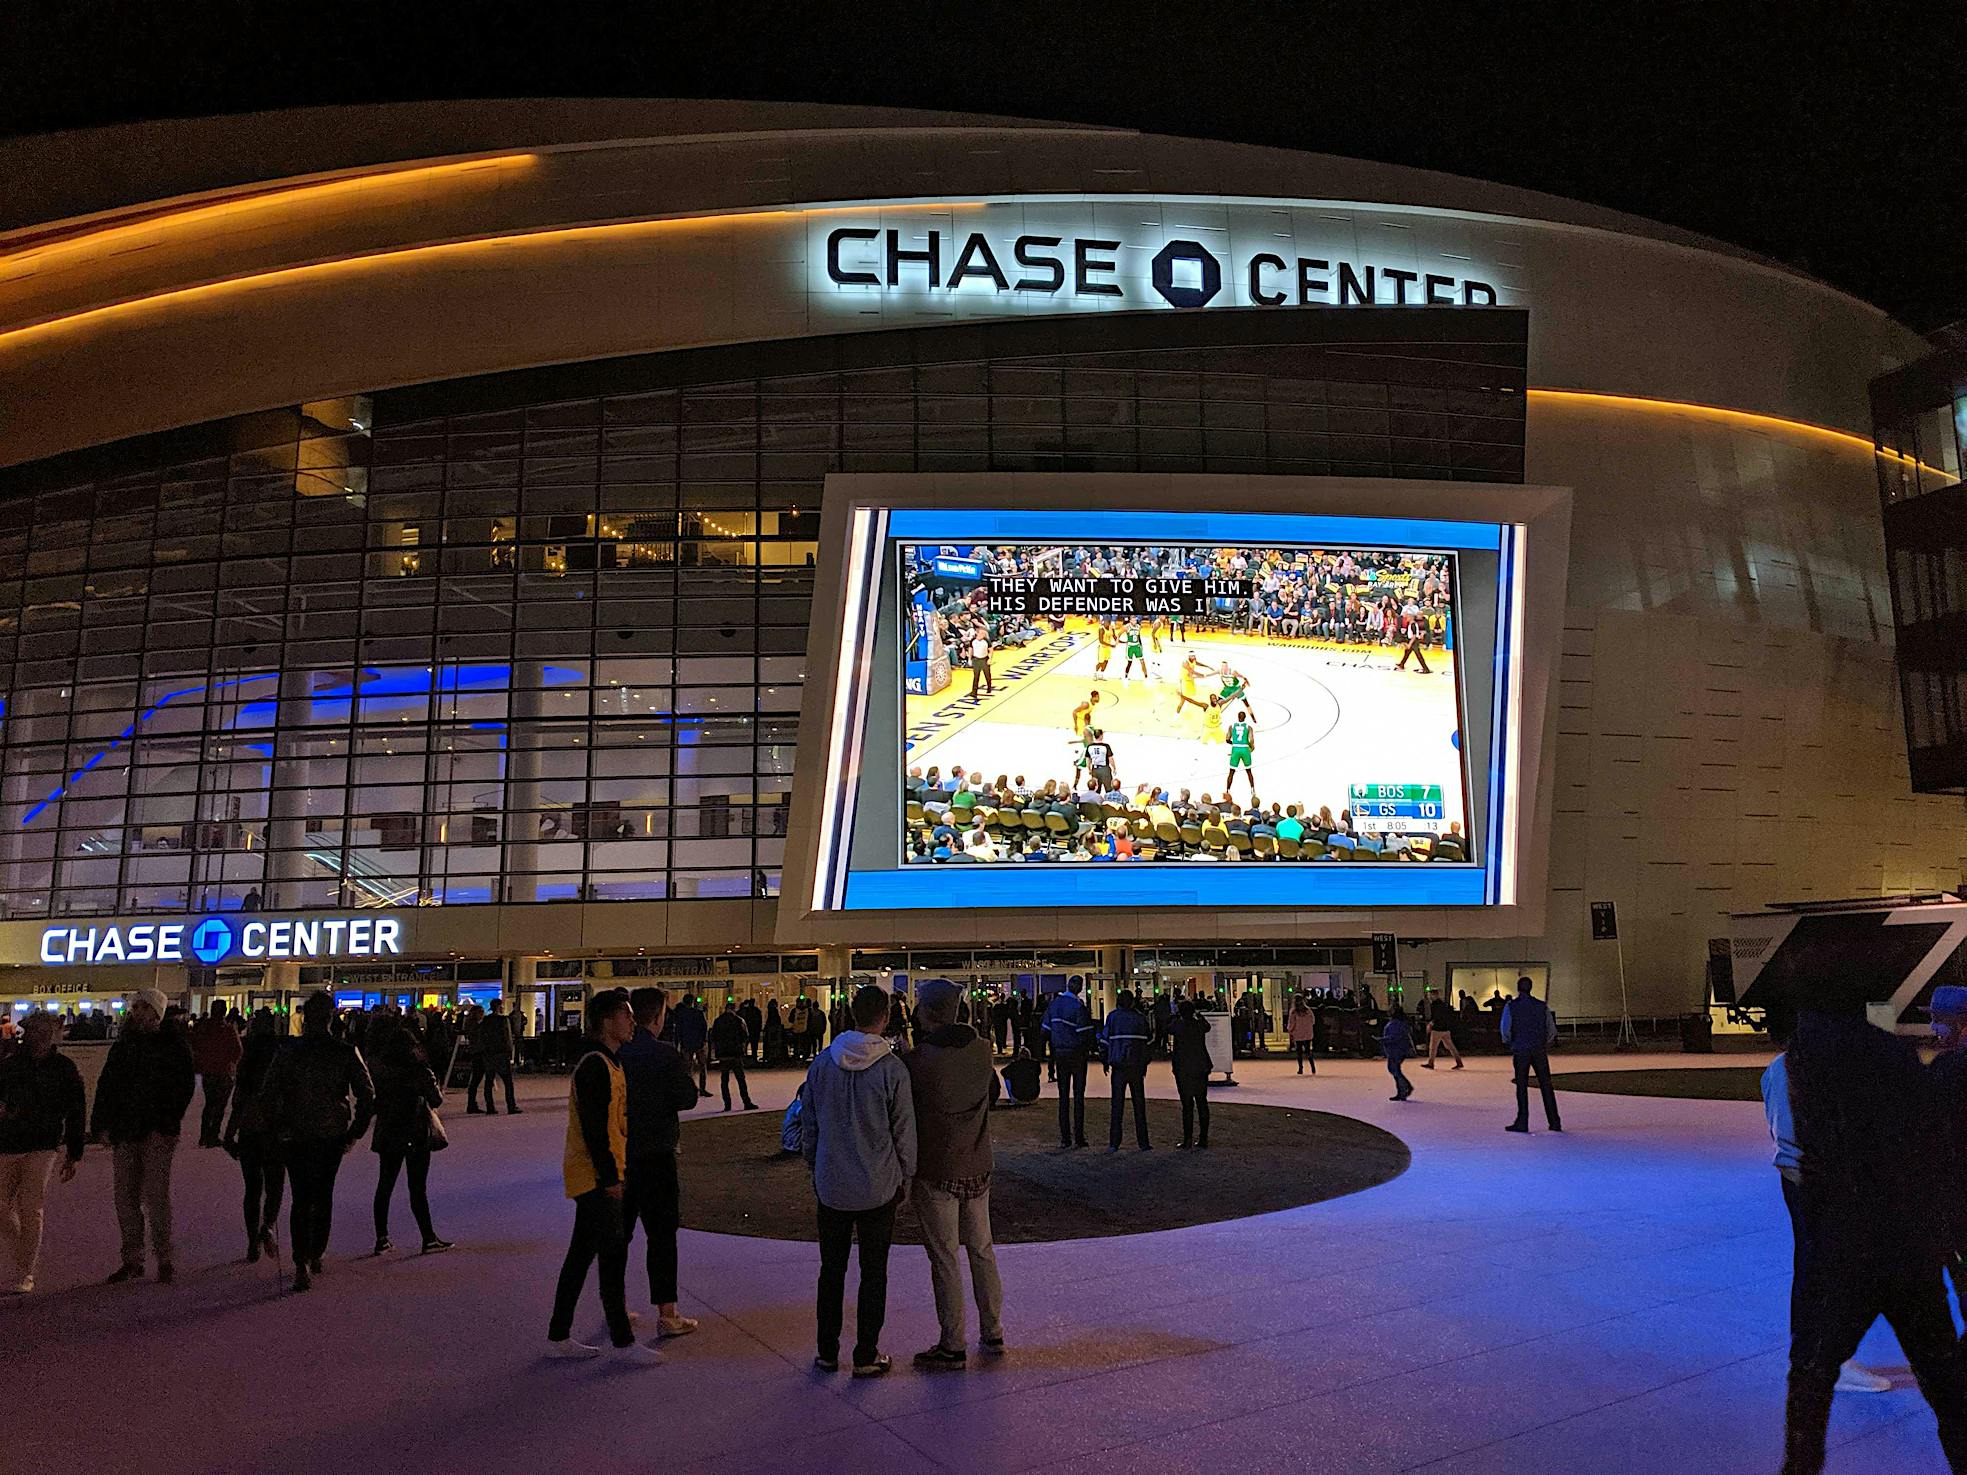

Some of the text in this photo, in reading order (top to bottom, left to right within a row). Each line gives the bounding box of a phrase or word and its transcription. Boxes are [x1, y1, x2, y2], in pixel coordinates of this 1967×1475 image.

[827, 228, 1123, 296] CHASE
[1376, 569, 1412, 582] Sports
[989, 578, 1249, 595] THEY WANT TO GIVE HIM.
[989, 597, 1204, 612] HIS DEFENDER WAS I
[1377, 785, 1431, 799] BOS 7
[1379, 803, 1436, 817] GS 10
[1363, 821, 1376, 830] 1st
[41, 919, 399, 962] CHASE CENTER
[351, 973, 379, 983] WEST
[637, 967, 666, 976] WEST
[33, 983, 88, 994] BOX OFFICE
